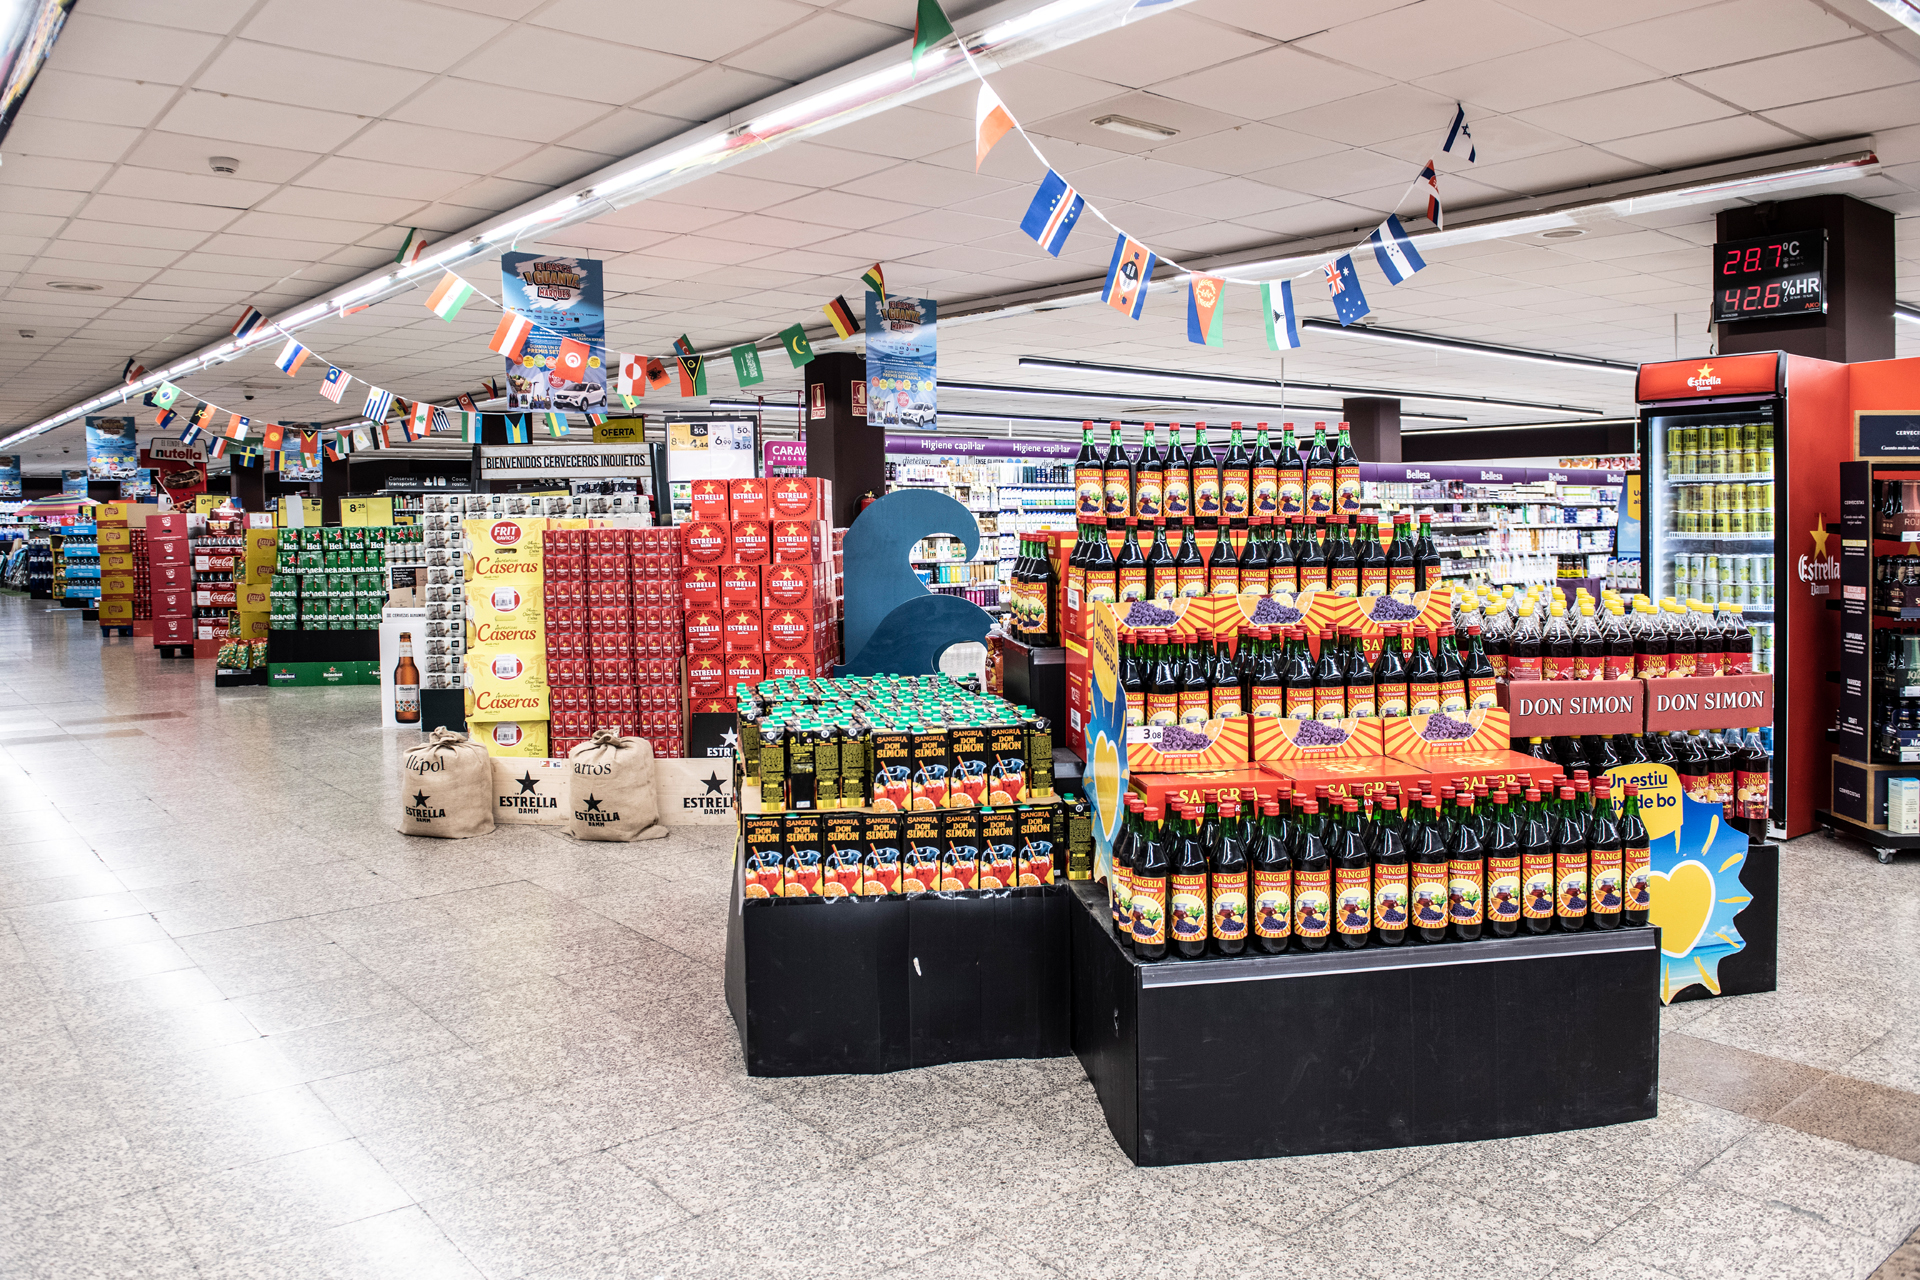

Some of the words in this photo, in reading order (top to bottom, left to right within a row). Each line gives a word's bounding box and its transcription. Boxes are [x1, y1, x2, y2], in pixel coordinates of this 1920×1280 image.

[1723, 244, 1782, 275] 28.7
[533, 270, 580, 288] GUANYA
[539, 288, 571, 300] MARQUES
[1724, 283, 1781, 311] 42.6
[1782, 278, 1820, 296] %HR
[1687, 376, 1722, 387] Estrella
[600, 428, 636, 437] OFERTA
[921, 440, 952, 451] Higiene
[1013, 443, 1041, 454] Higiene
[156, 448, 202, 460] nutella
[486, 457, 542, 469] BIENVENIDOS
[543, 455, 599, 468] CERVECEROS
[601, 454, 646, 467] INQUIETOS
[1406, 469, 1430, 480] Bellesa
[1481, 471, 1503, 481] Bellesa
[1548, 473, 1568, 482] Bellesa
[494, 526, 517, 536] FRIT
[476, 557, 538, 575] Caseras
[1798, 554, 1840, 582] Estrella
[478, 624, 536, 642] Caseras
[476, 692, 540, 710] Caseras
[1519, 698, 1564, 716] DON
[1570, 696, 1633, 714] SIMON
[1657, 694, 1698, 712] DON
[1704, 691, 1764, 710] SIMON
[953, 743, 983, 752] SIMON
[992, 741, 1022, 750] SIMON
[876, 750, 908, 758] SIMON
[914, 748, 945, 757] SIMON
[1631, 771, 1668, 786] estiu
[499, 796, 557, 808] ESTRELLA
[1657, 793, 1676, 807] bo
[406, 806, 446, 818] ESTRELLA
[575, 811, 620, 822] ESTRELLA
[907, 829, 938, 838] SIMON
[946, 829, 976, 838] SIMON
[982, 828, 1013, 837] SIMON
[1021, 824, 1050, 833] SIMON
[748, 834, 779, 843] SIMON
[786, 833, 818, 842] SIMON
[828, 832, 859, 841] SIMON
[1449, 862, 1480, 870] ANGRIA
[1256, 873, 1290, 882] SANGRIA
[1296, 873, 1329, 881] SANGRIA
